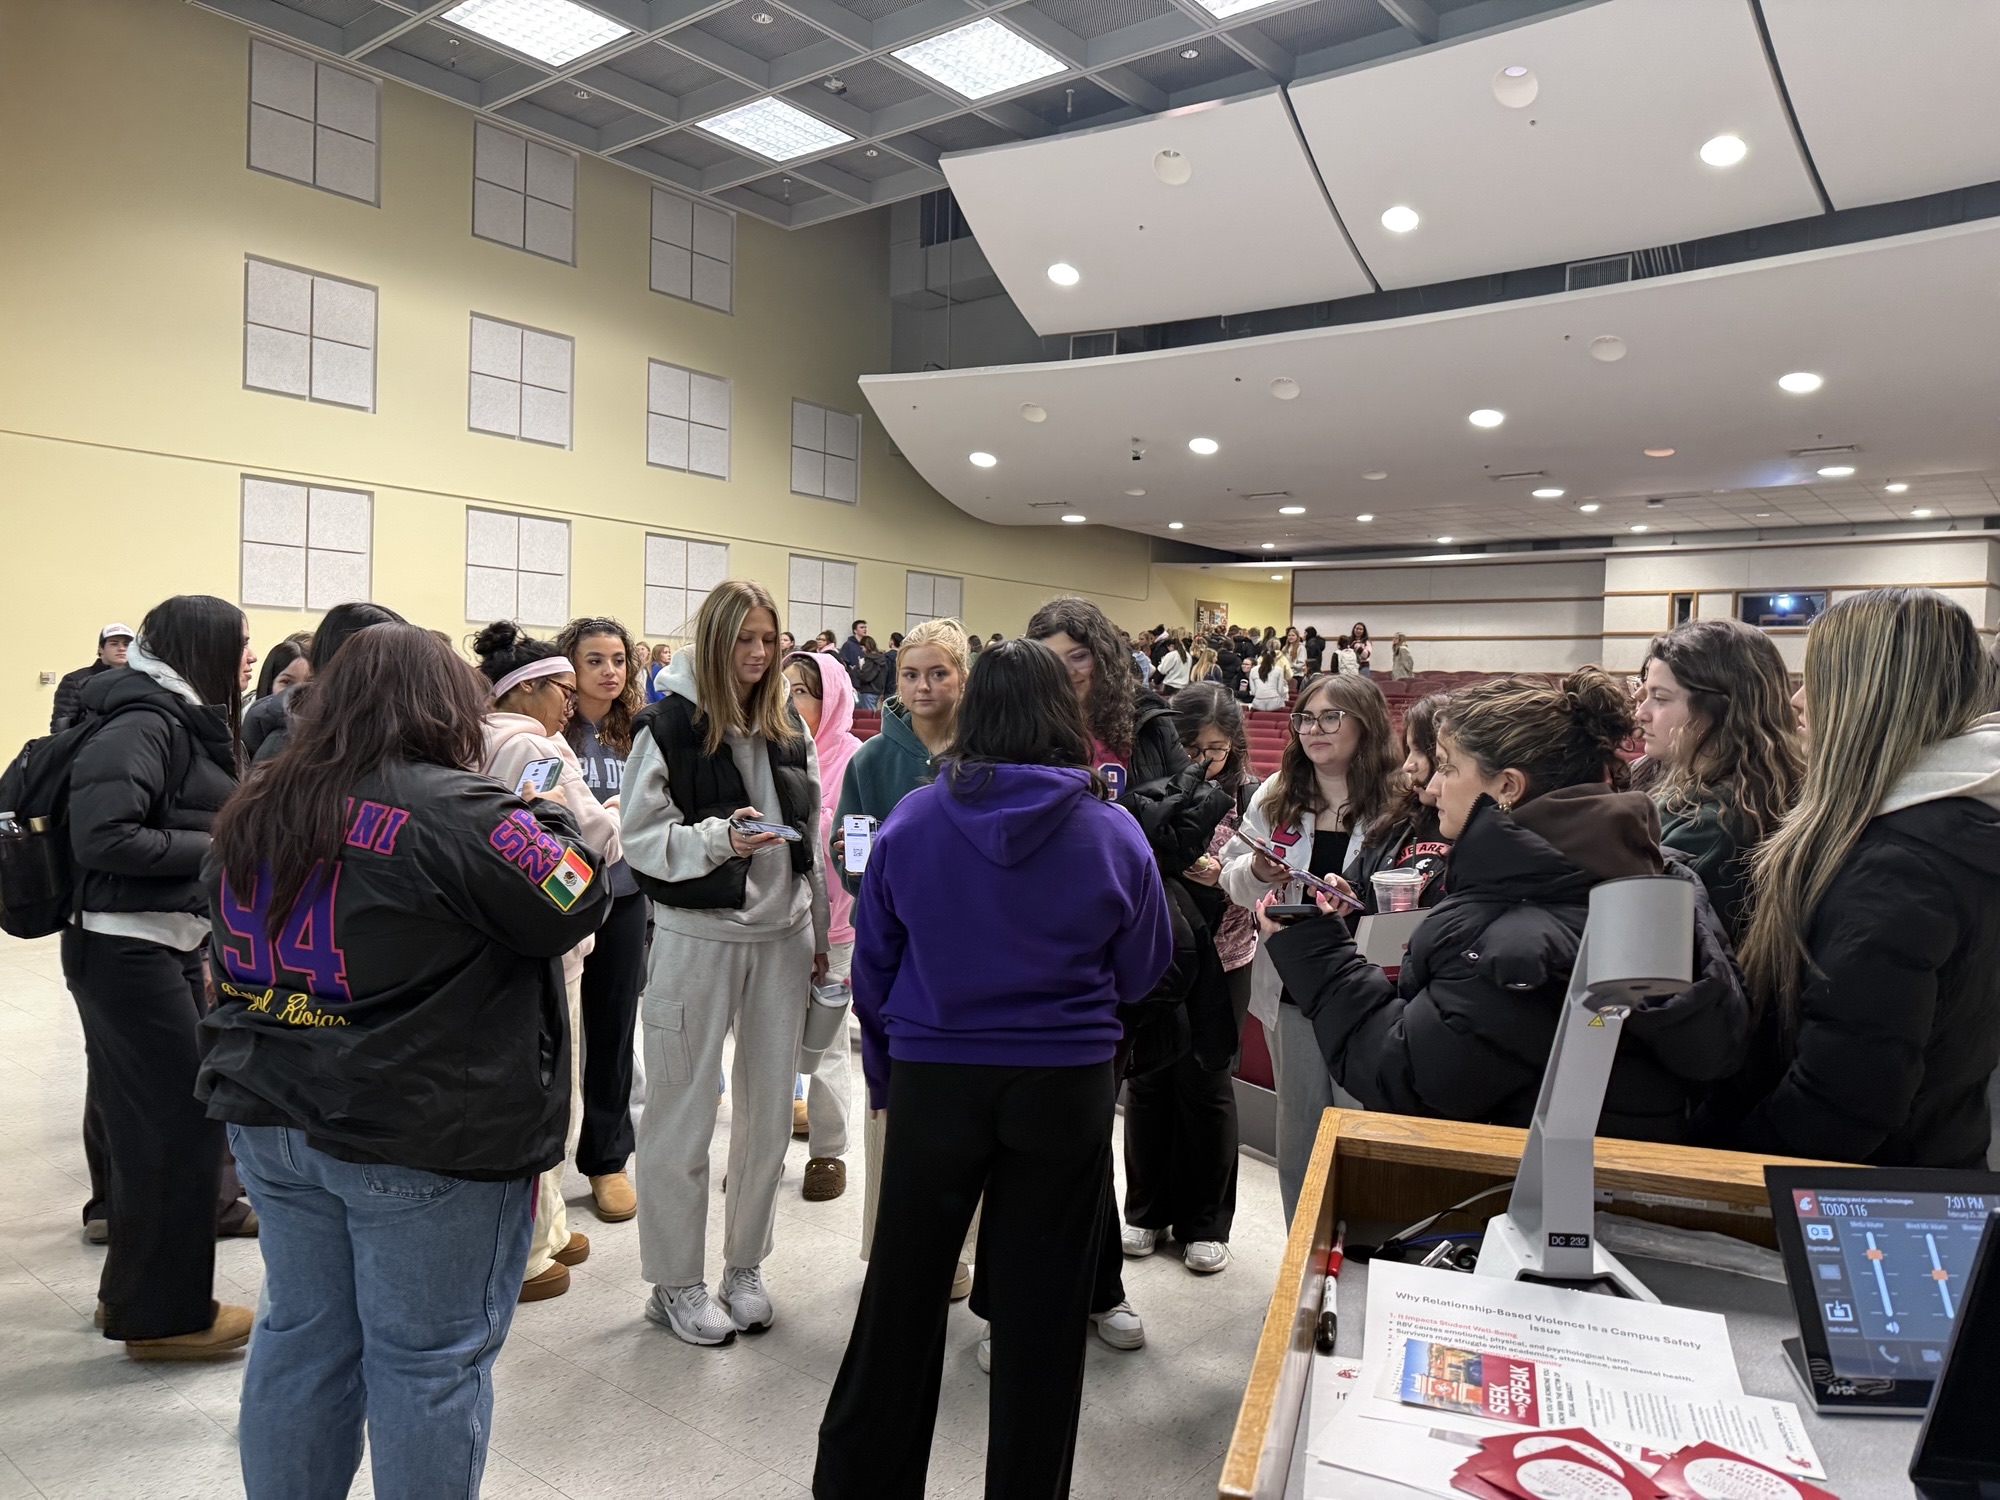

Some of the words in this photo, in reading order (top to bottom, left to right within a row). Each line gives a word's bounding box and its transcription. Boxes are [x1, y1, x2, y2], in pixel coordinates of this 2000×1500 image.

[345, 796, 410, 855] NI
[489, 808, 541, 862] SP
[518, 832, 564, 884] 23
[1419, 844, 1444, 852] ARE
[220, 858, 352, 1002] 94
[1821, 1203, 1847, 1216] TODD
[1850, 1204, 1868, 1216] 116
[1945, 1196, 1965, 1209] 7:01
[1967, 1197, 1984, 1209] PM
[1552, 1236, 1565, 1245] DC
[1570, 1237, 1586, 1246] 232
[1396, 1292, 1420, 1302] Why
[1423, 1296, 1532, 1320] Relationship-Based
[1534, 1315, 1585, 1330] Violence
[1611, 1327, 1660, 1342] Campus
[1663, 1336, 1701, 1350] Safety
[1405, 1315, 1437, 1325] Impacts
[1440, 1320, 1471, 1330] Student
[1472, 1325, 1517, 1339] Well-Being
[1530, 1324, 1560, 1336] Issue
[1396, 1328, 1433, 1339] Survivors
[1435, 1334, 1452, 1343] may
[1454, 1336, 1487, 1348] struggle
[1489, 1342, 1507, 1351] with
[1508, 1346, 1558, 1360] academics,
[1559, 1354, 1610, 1369] attendance,
[1630, 1367, 1660, 1377] mental
[1663, 1372, 1695, 1382] health.
[1414, 1324, 1443, 1332] causes
[1444, 1328, 1488, 1341] emotional,
[1490, 1335, 1527, 1348] physical,
[1529, 1342, 1545, 1350] and
[1547, 1346, 1605, 1360] psychological
[1607, 1355, 1632, 1365] harm.
[1489, 1382, 1509, 1415] SEEK
[1510, 1365, 1531, 1405] SPEAK
